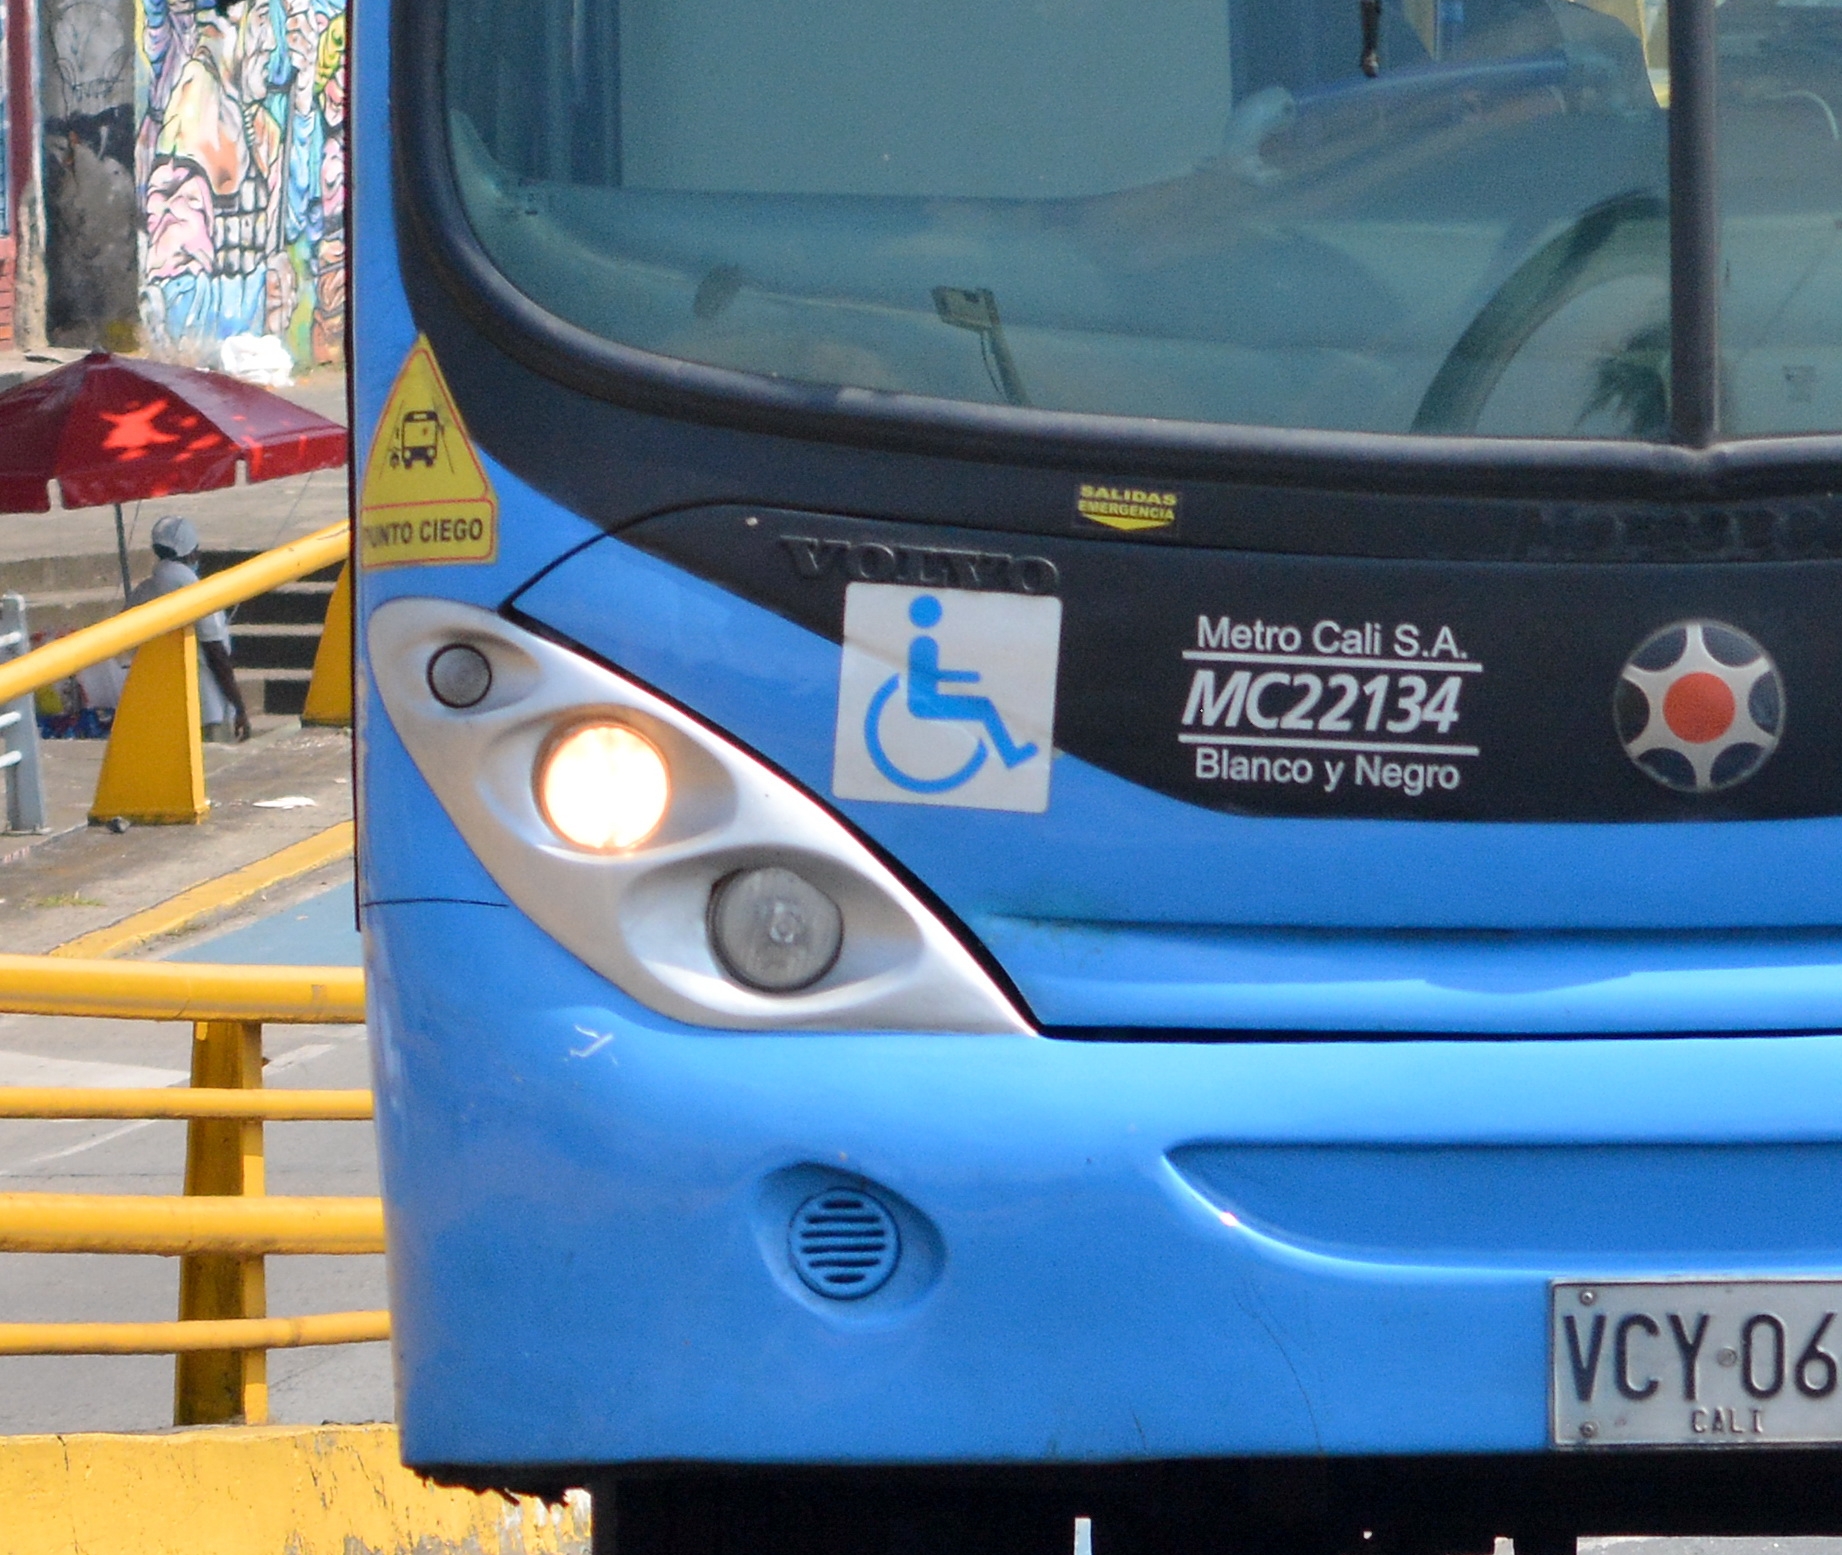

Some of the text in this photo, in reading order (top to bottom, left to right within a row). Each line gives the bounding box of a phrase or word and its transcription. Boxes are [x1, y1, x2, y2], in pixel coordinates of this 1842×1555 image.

[1081, 485, 1177, 506] SALIDAS
[1078, 499, 1175, 521] EMERGENCIA
[419, 517, 484, 544] CIEGO
[1197, 615, 1469, 660] Metro Cali S.A.
[1180, 668, 1464, 735] MC22134
[1194, 747, 1460, 797] Blanco y Negro
[1691, 1407, 1766, 1435] CALI
